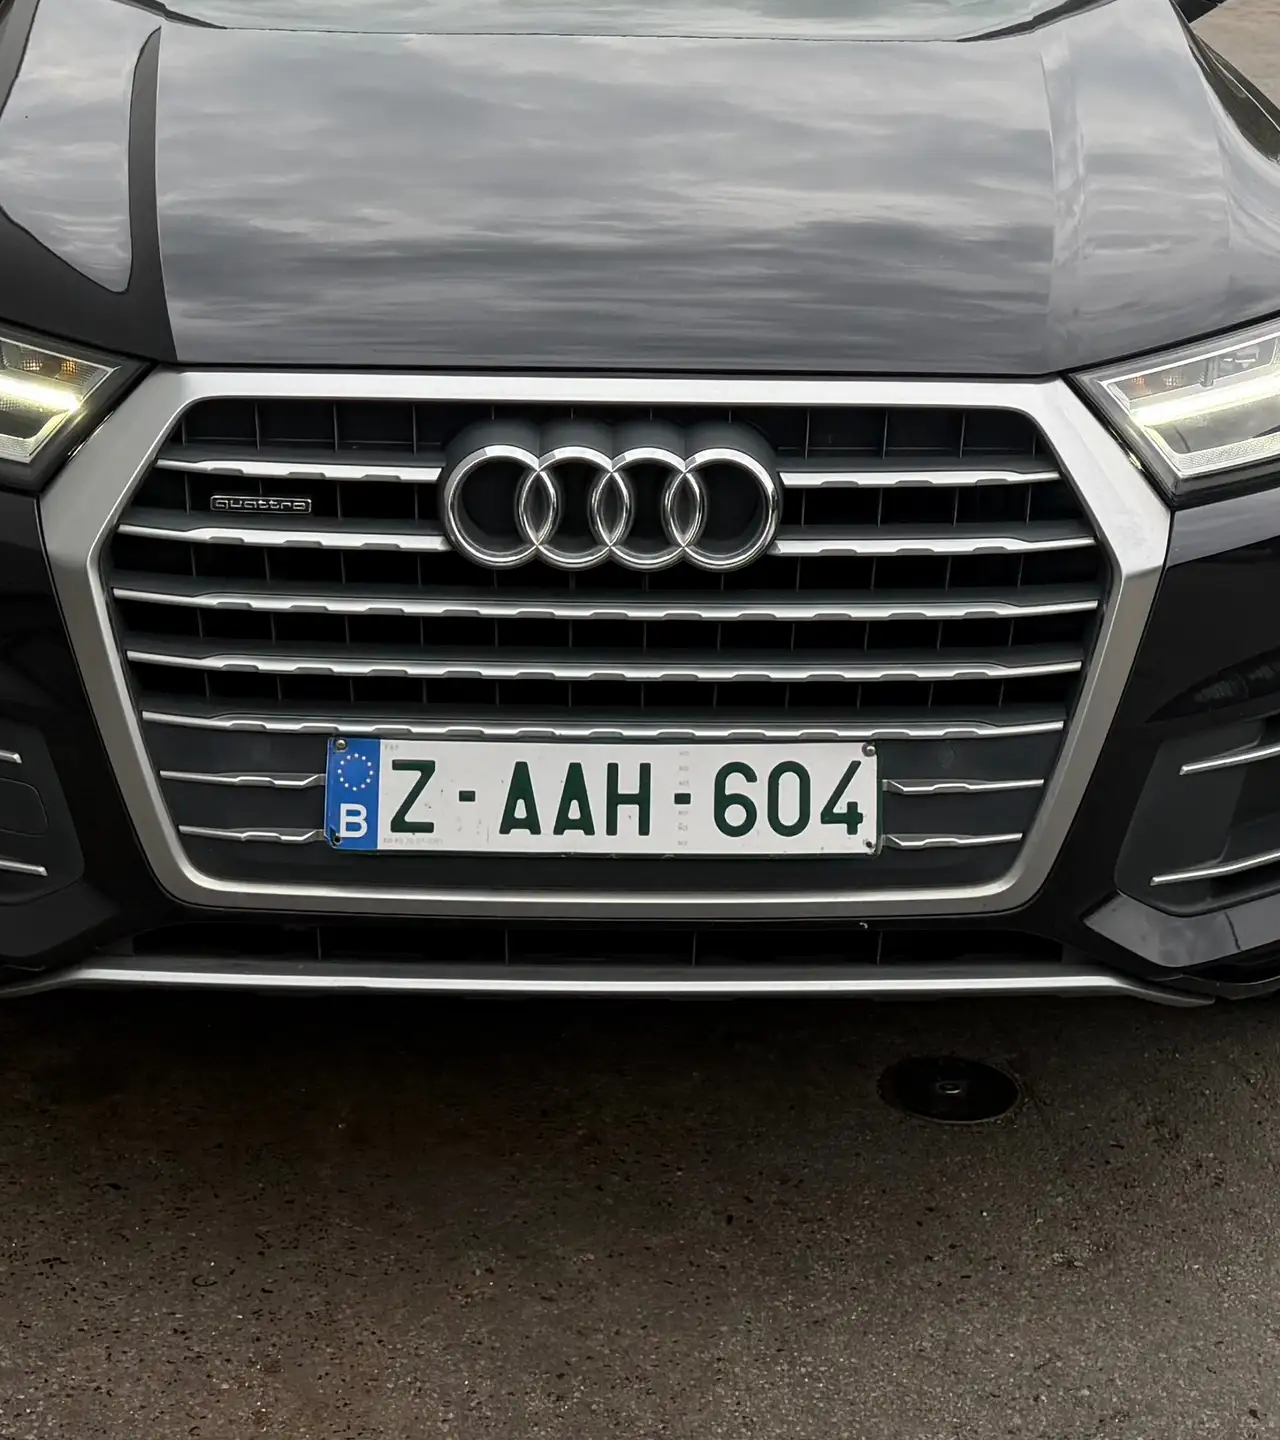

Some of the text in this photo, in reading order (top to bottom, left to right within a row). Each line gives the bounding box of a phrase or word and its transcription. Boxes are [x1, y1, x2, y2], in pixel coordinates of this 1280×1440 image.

[215, 499, 306, 509] quattro
[390, 759, 863, 837] Z-AAH-604
[339, 803, 368, 838] B
